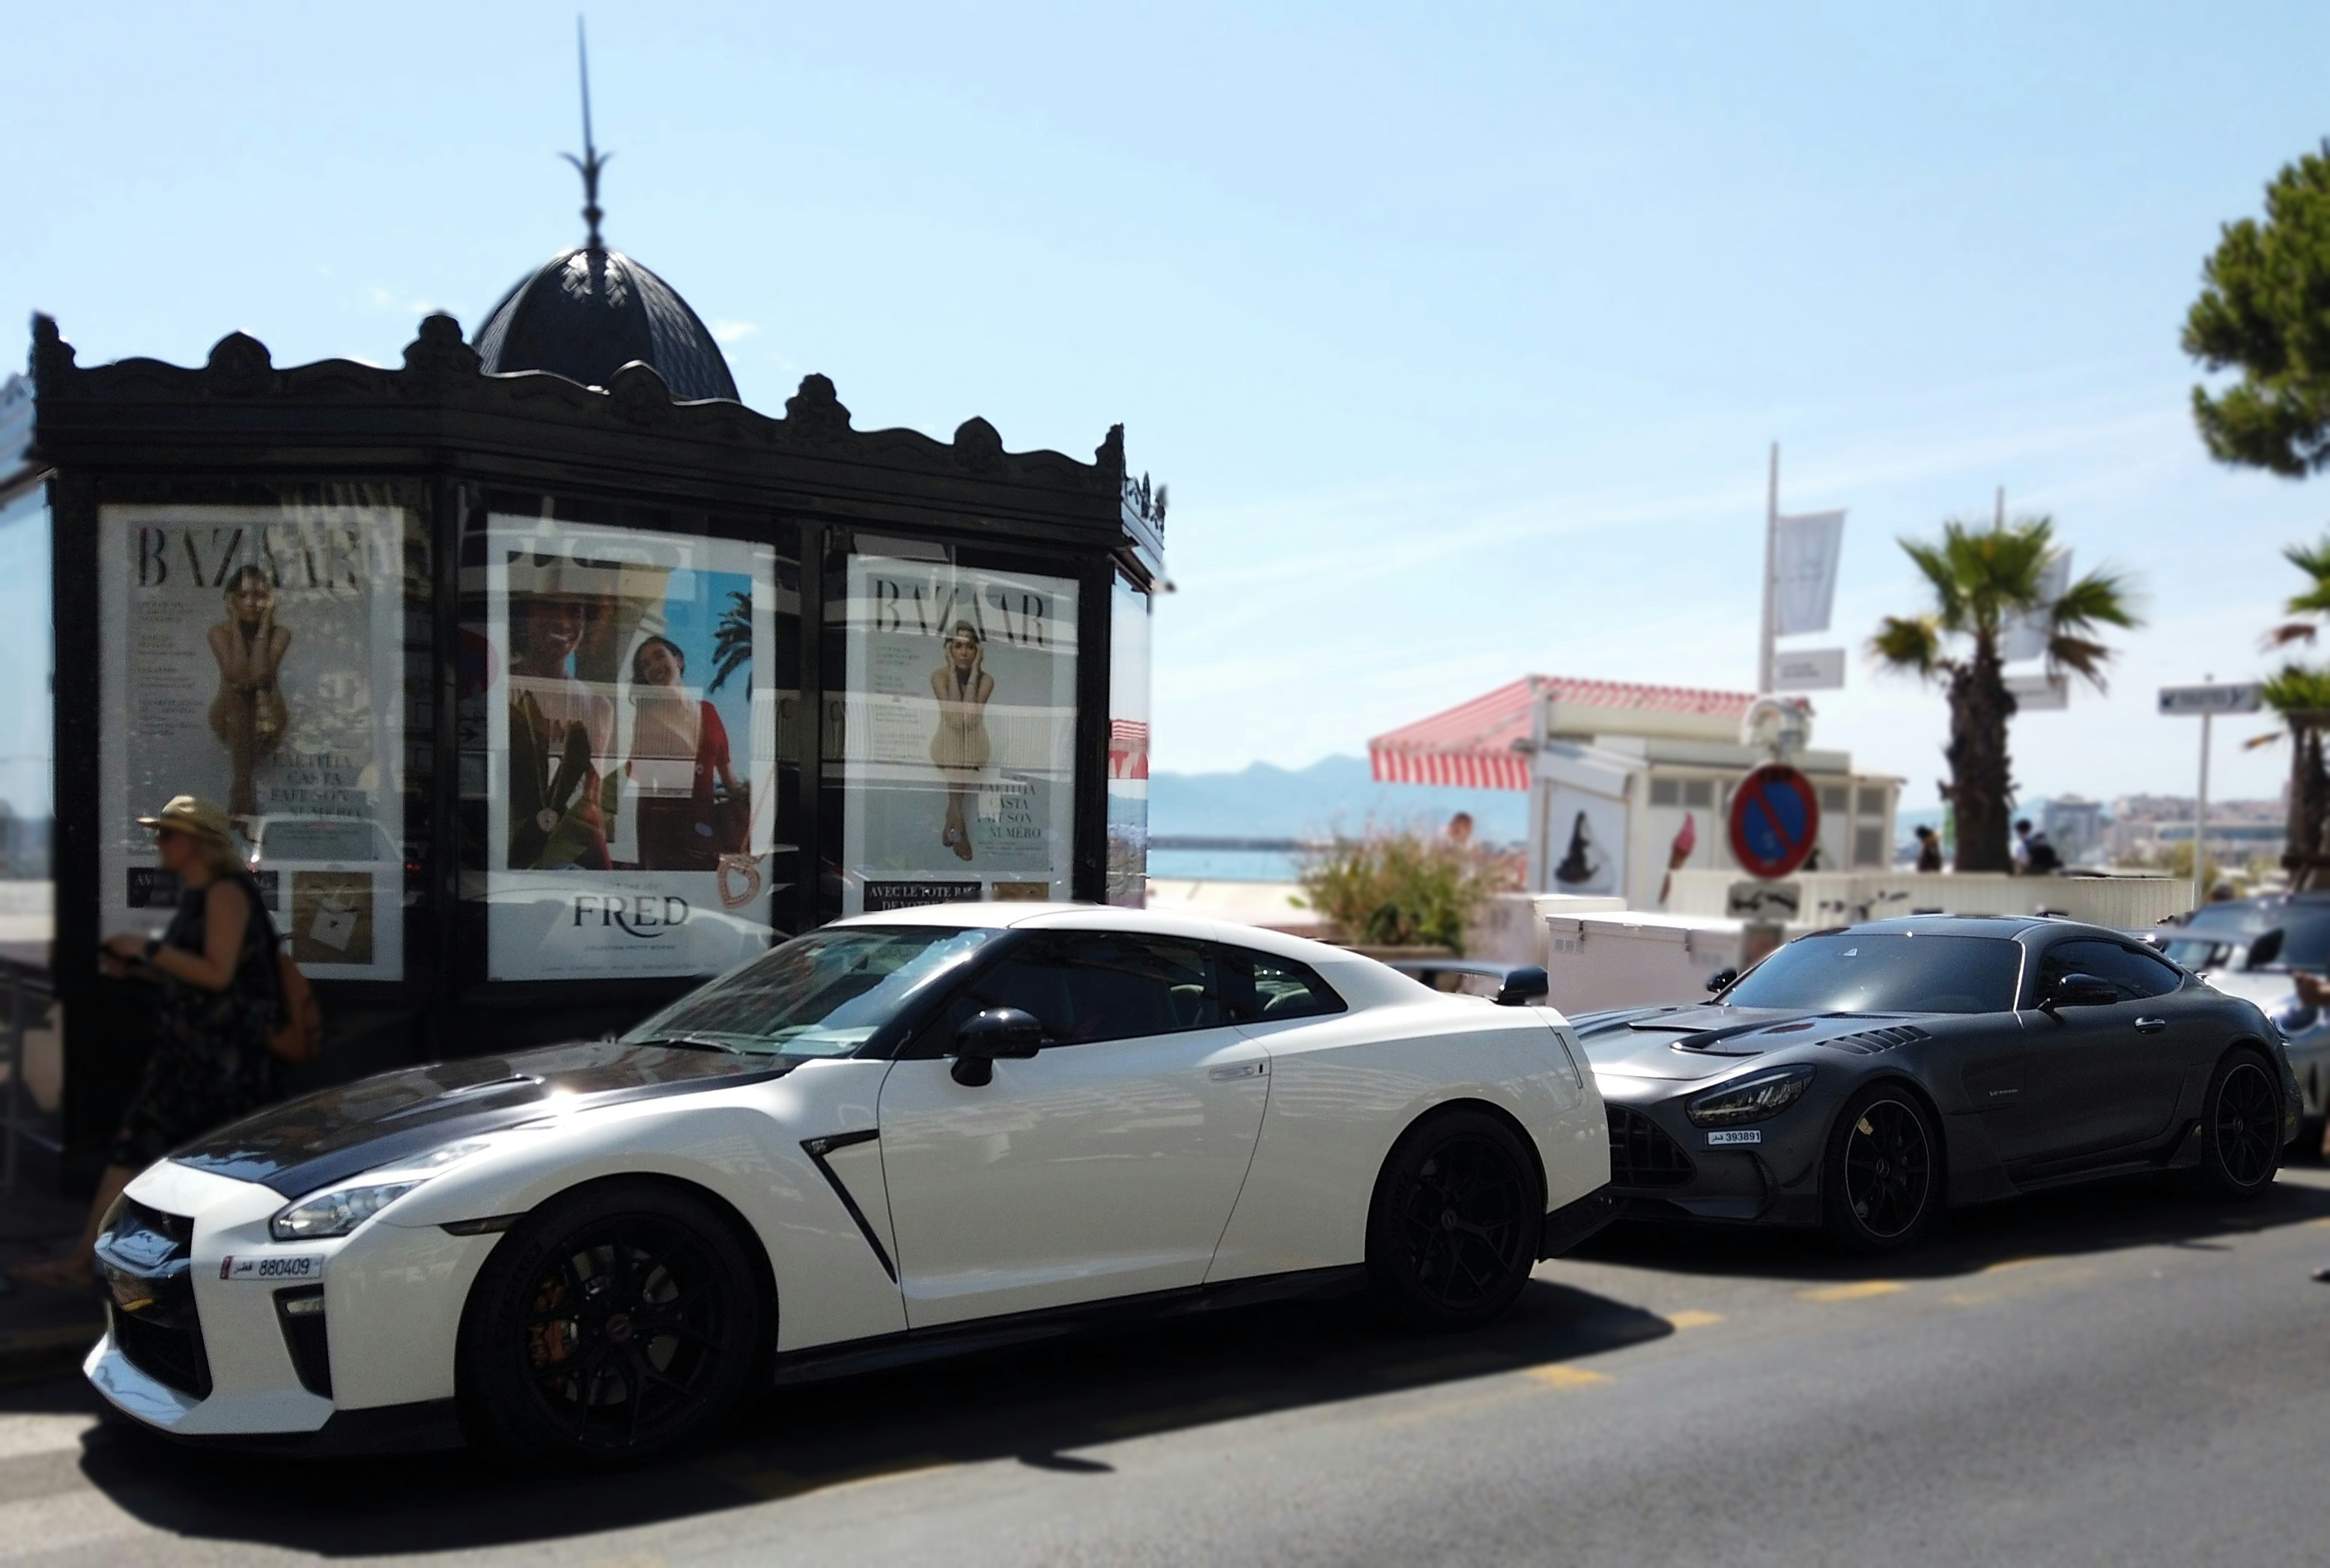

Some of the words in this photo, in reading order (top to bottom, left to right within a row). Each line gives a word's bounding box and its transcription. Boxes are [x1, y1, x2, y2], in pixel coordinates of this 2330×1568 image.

[139, 526, 359, 591] BAZAAR
[876, 579, 1043, 647] BAZAAR
[870, 886, 900, 898] AVEC
[903, 886, 917, 898] LE
[919, 886, 952, 898] TOTE
[572, 896, 690, 938] FRED
[1726, 1132, 1760, 1142] 393891
[258, 1258, 310, 1276] 880409
